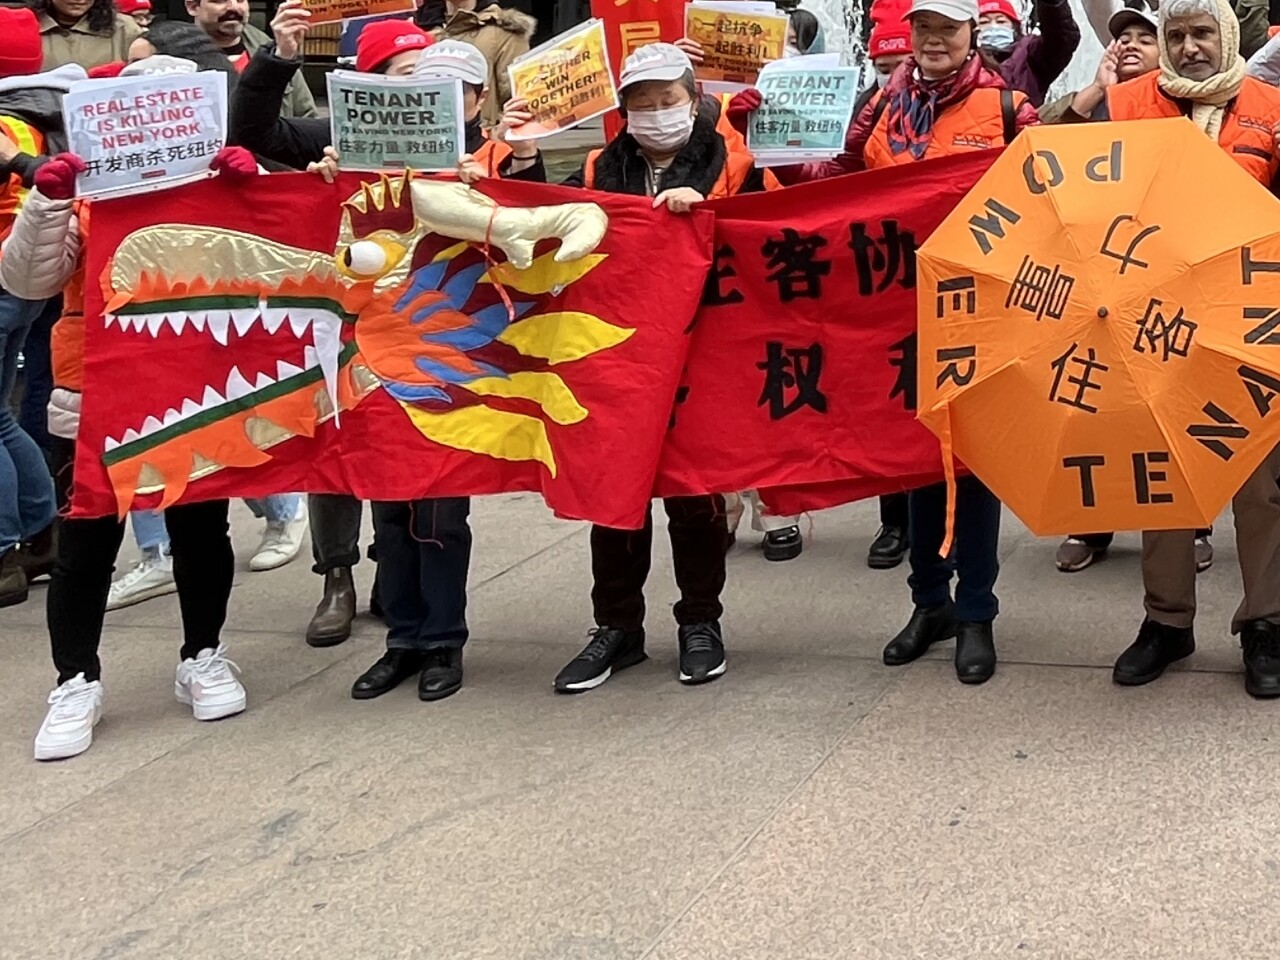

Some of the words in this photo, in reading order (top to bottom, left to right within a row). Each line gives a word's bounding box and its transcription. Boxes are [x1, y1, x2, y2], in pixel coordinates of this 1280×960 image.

[702, 20, 763, 37] 一起抗争
[545, 72, 569, 90] WIN
[765, 76, 845, 89] TENANT
[83, 99, 129, 117] REAL
[134, 87, 204, 108] ESTATE
[340, 88, 440, 107] TENANT
[765, 92, 836, 105] POWER
[97, 119, 114, 133] IS
[121, 106, 195, 128] KILLING
[347, 108, 436, 125] POWER
[102, 131, 144, 150] NEW
[150, 122, 201, 140] YORK
[339, 139, 400, 154] 住客力量
[84, 138, 222, 178] 开发商杀死纽约
